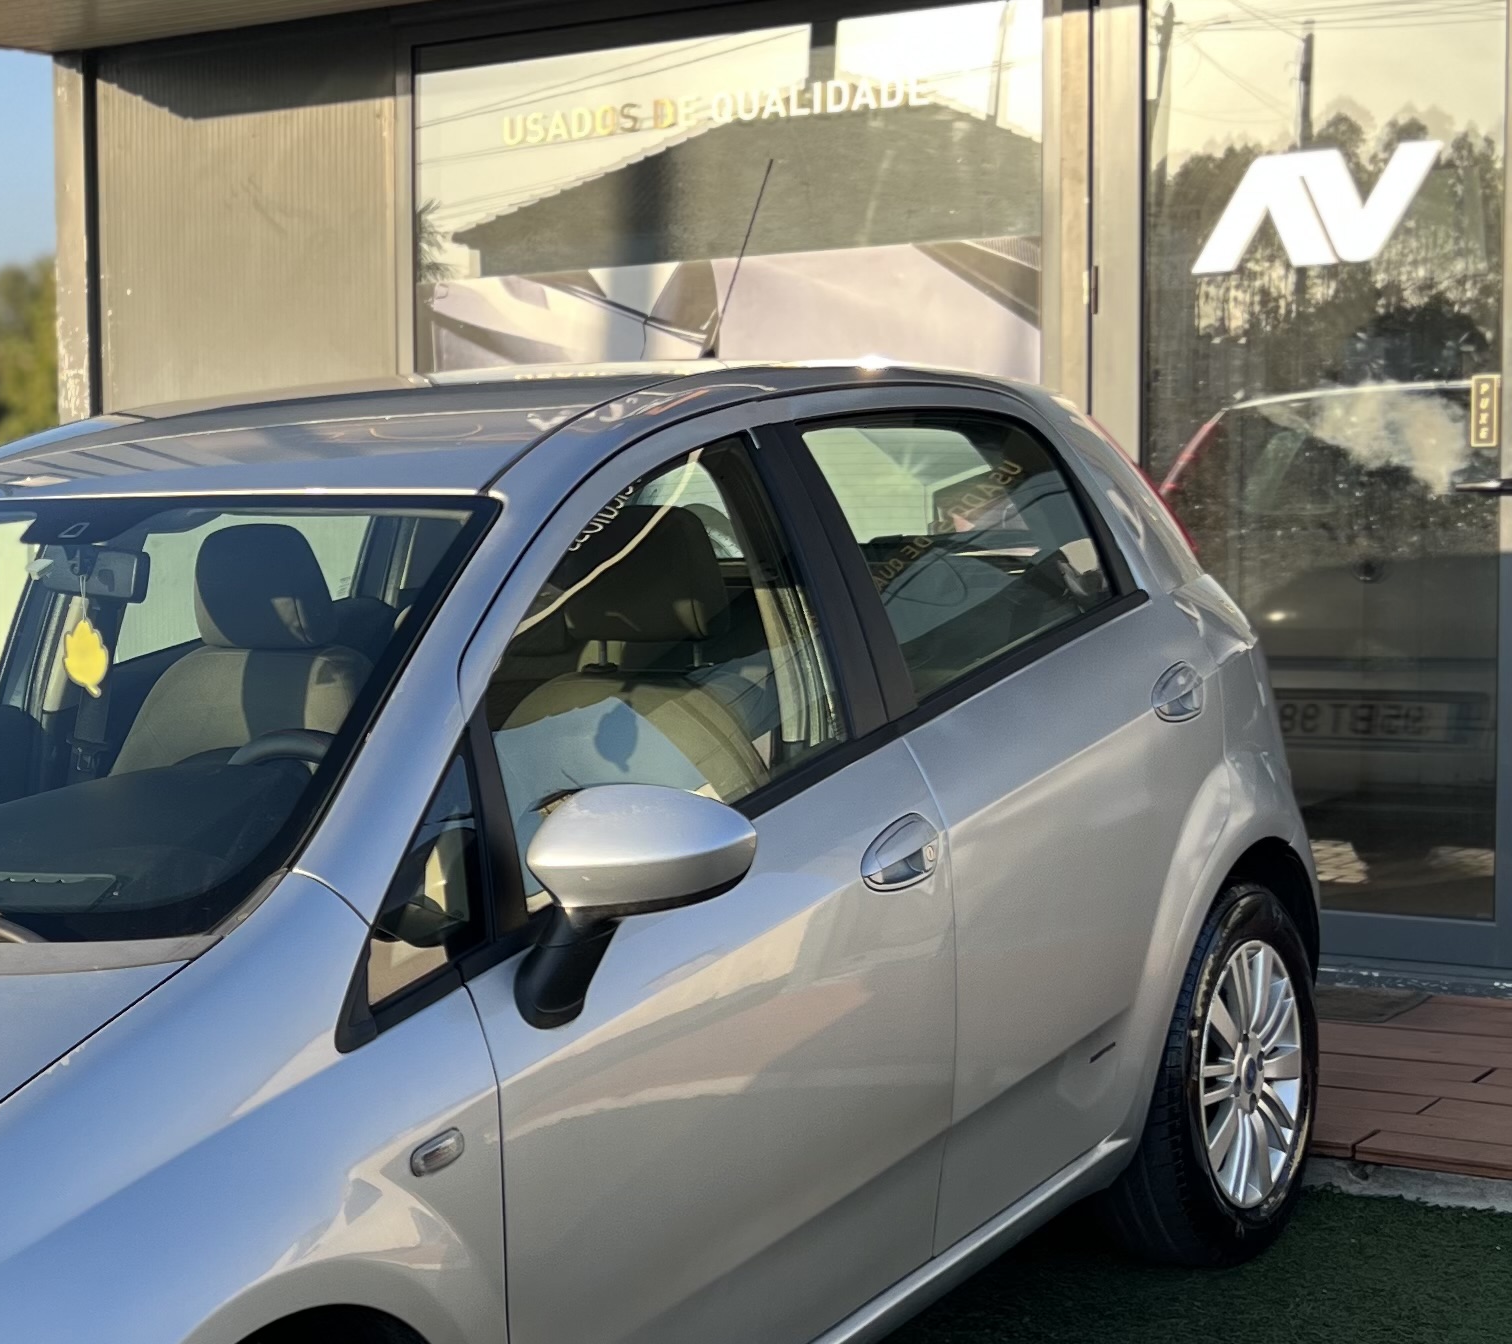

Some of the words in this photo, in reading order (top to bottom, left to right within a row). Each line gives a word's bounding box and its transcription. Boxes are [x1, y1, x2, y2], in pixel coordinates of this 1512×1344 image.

[502, 103, 640, 146] USADOS
[652, 95, 697, 130] DE
[711, 76, 931, 124] QUALIDADE
